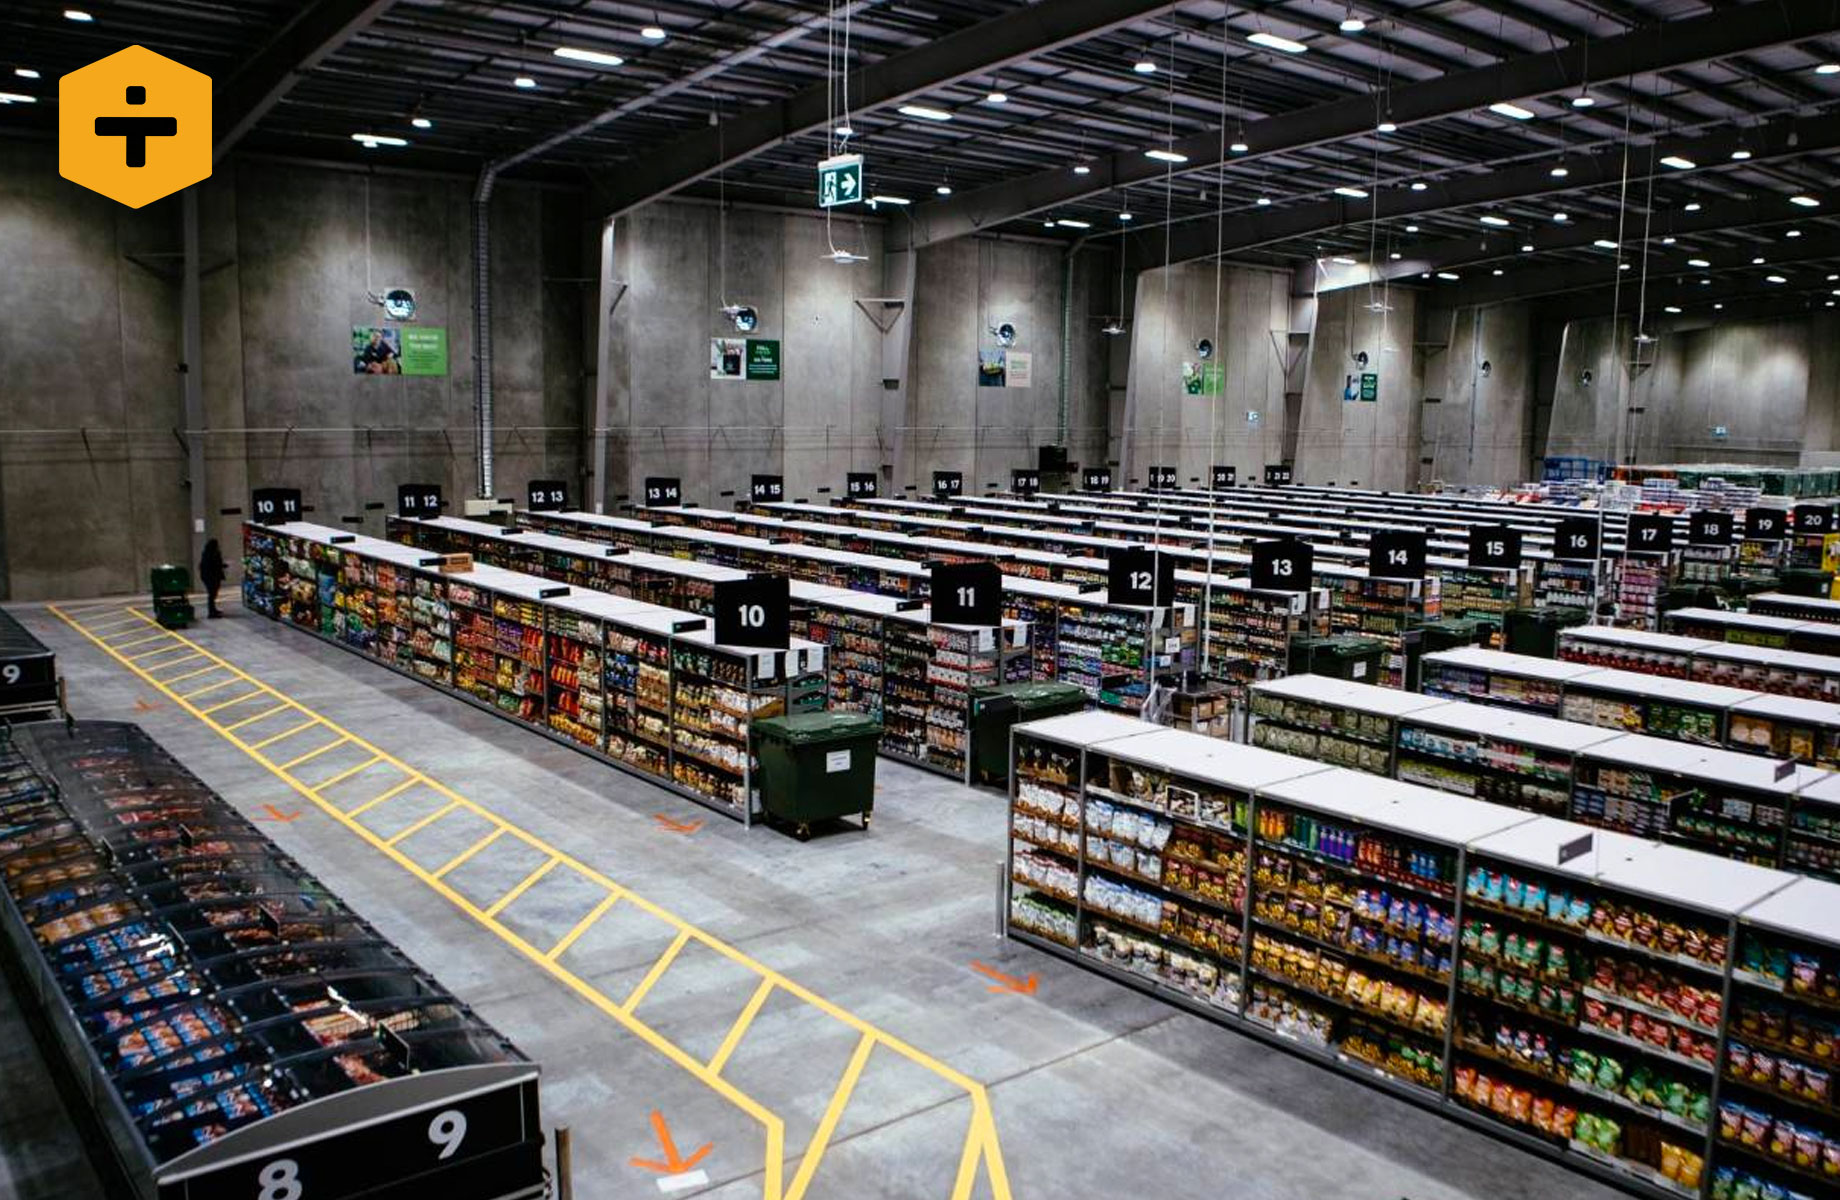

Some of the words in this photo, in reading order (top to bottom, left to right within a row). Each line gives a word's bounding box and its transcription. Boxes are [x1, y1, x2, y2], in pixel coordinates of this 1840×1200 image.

[754, 485, 765, 495] 14
[770, 485, 781, 494] 15
[864, 481, 875, 491] 16
[937, 480, 948, 490] 16
[950, 480, 960, 489] 17
[531, 491, 545, 503] 12
[550, 491, 564, 502] 13
[648, 487, 660, 499] 13
[665, 487, 678, 498] 14
[257, 500, 274, 513] 10
[283, 500, 295, 513] 11
[404, 496, 415, 508] 11
[423, 495, 438, 507] 12
[1758, 519, 1773, 530] 19
[1804, 514, 1823, 526] 20
[1641, 528, 1657, 541] 17
[1704, 523, 1719, 536] 18
[1570, 534, 1588, 548] 16
[1486, 541, 1504, 556] 15
[1388, 549, 1408, 565] 14
[1271, 558, 1293, 576] 13
[1130, 571, 1152, 590] 12
[956, 587, 975, 607] 11
[738, 604, 765, 627] 10
[2, 664, 21, 684] 9
[258, 1158, 303, 1200] 8
[428, 1110, 467, 1159] 9
